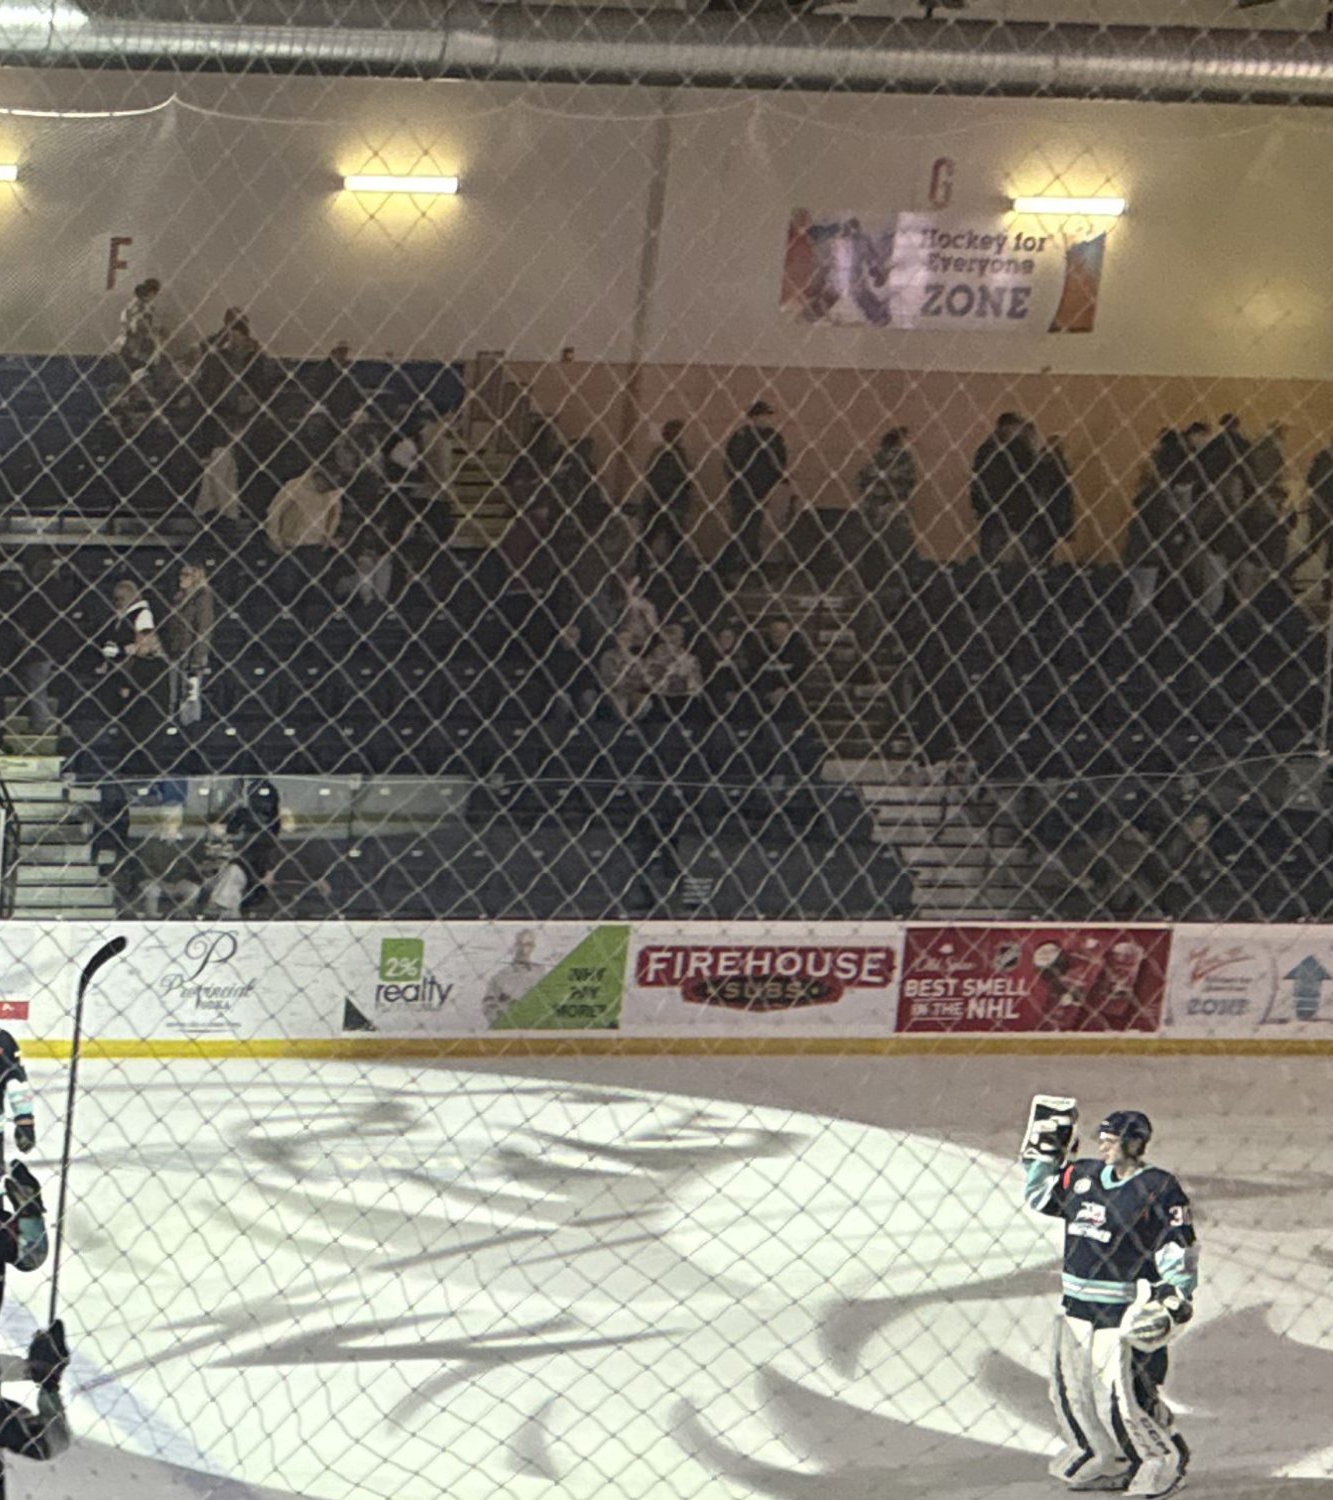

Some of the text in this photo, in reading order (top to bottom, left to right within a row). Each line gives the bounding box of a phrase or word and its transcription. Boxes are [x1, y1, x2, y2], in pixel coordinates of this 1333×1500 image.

[919, 283, 1033, 320] ZONE
[645, 950, 888, 984] FIREHOUSE
[375, 975, 453, 1005] realty
[723, 981, 803, 999] SUBS
[904, 977, 1030, 997] BEST SMELL
[931, 1001, 965, 1016] THE
[967, 998, 1021, 1019] NHL
